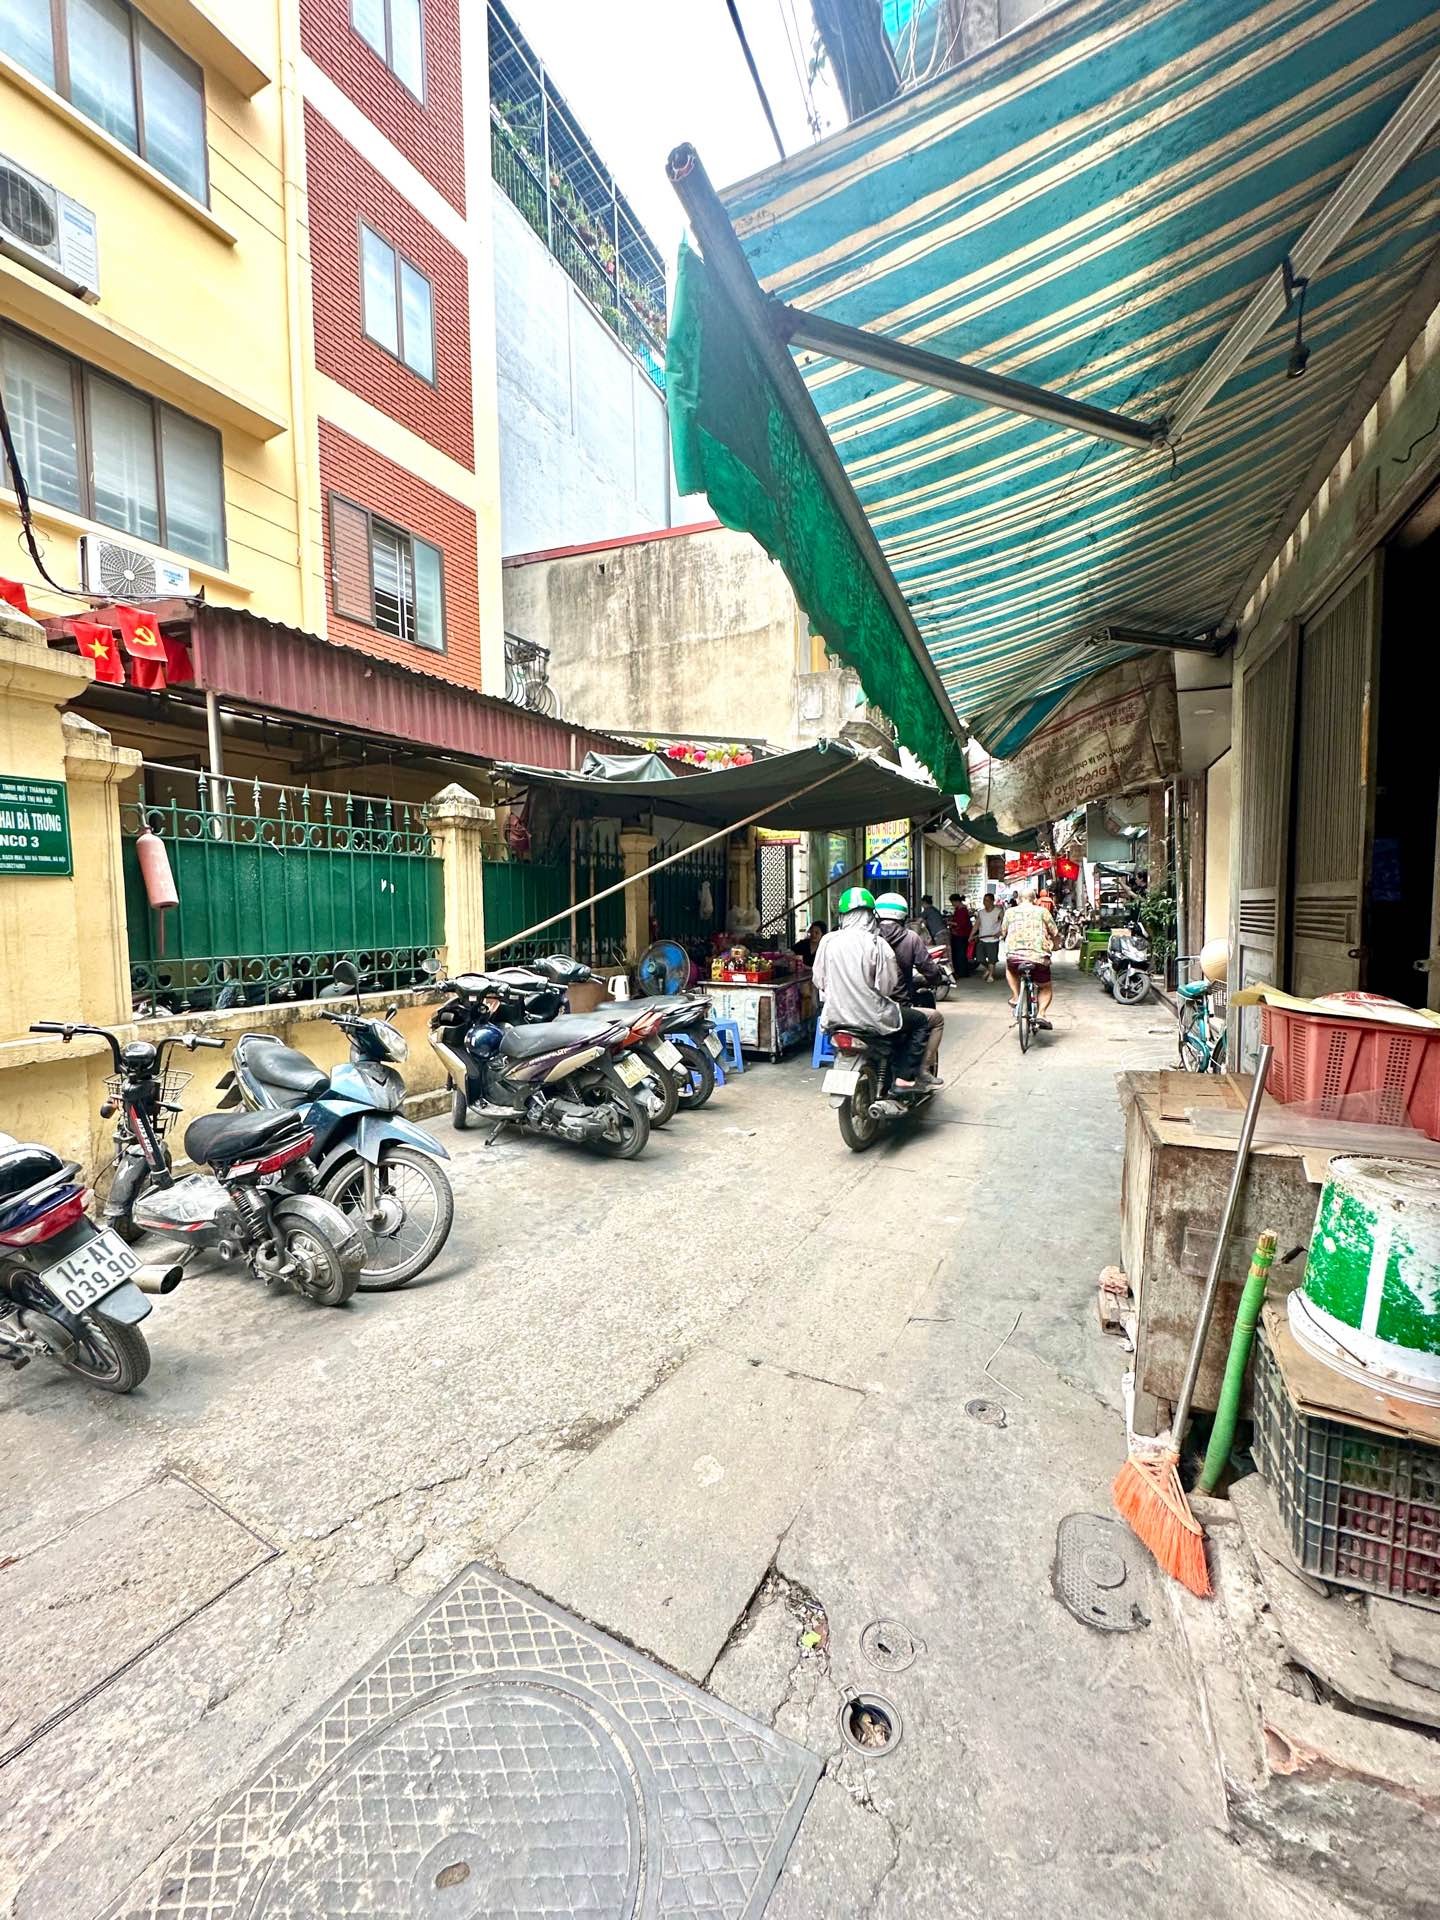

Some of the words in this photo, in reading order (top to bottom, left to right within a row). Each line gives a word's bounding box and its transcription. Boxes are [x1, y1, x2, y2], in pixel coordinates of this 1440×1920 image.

[16, 808, 31, 830] BÀ
[31, 812, 62, 832] TRƯNG
[30, 836, 40, 848] 3
[869, 861, 880, 875] 7
[56, 1238, 113, 1283] 14-AY
[65, 1251, 136, 1308] 039.90
